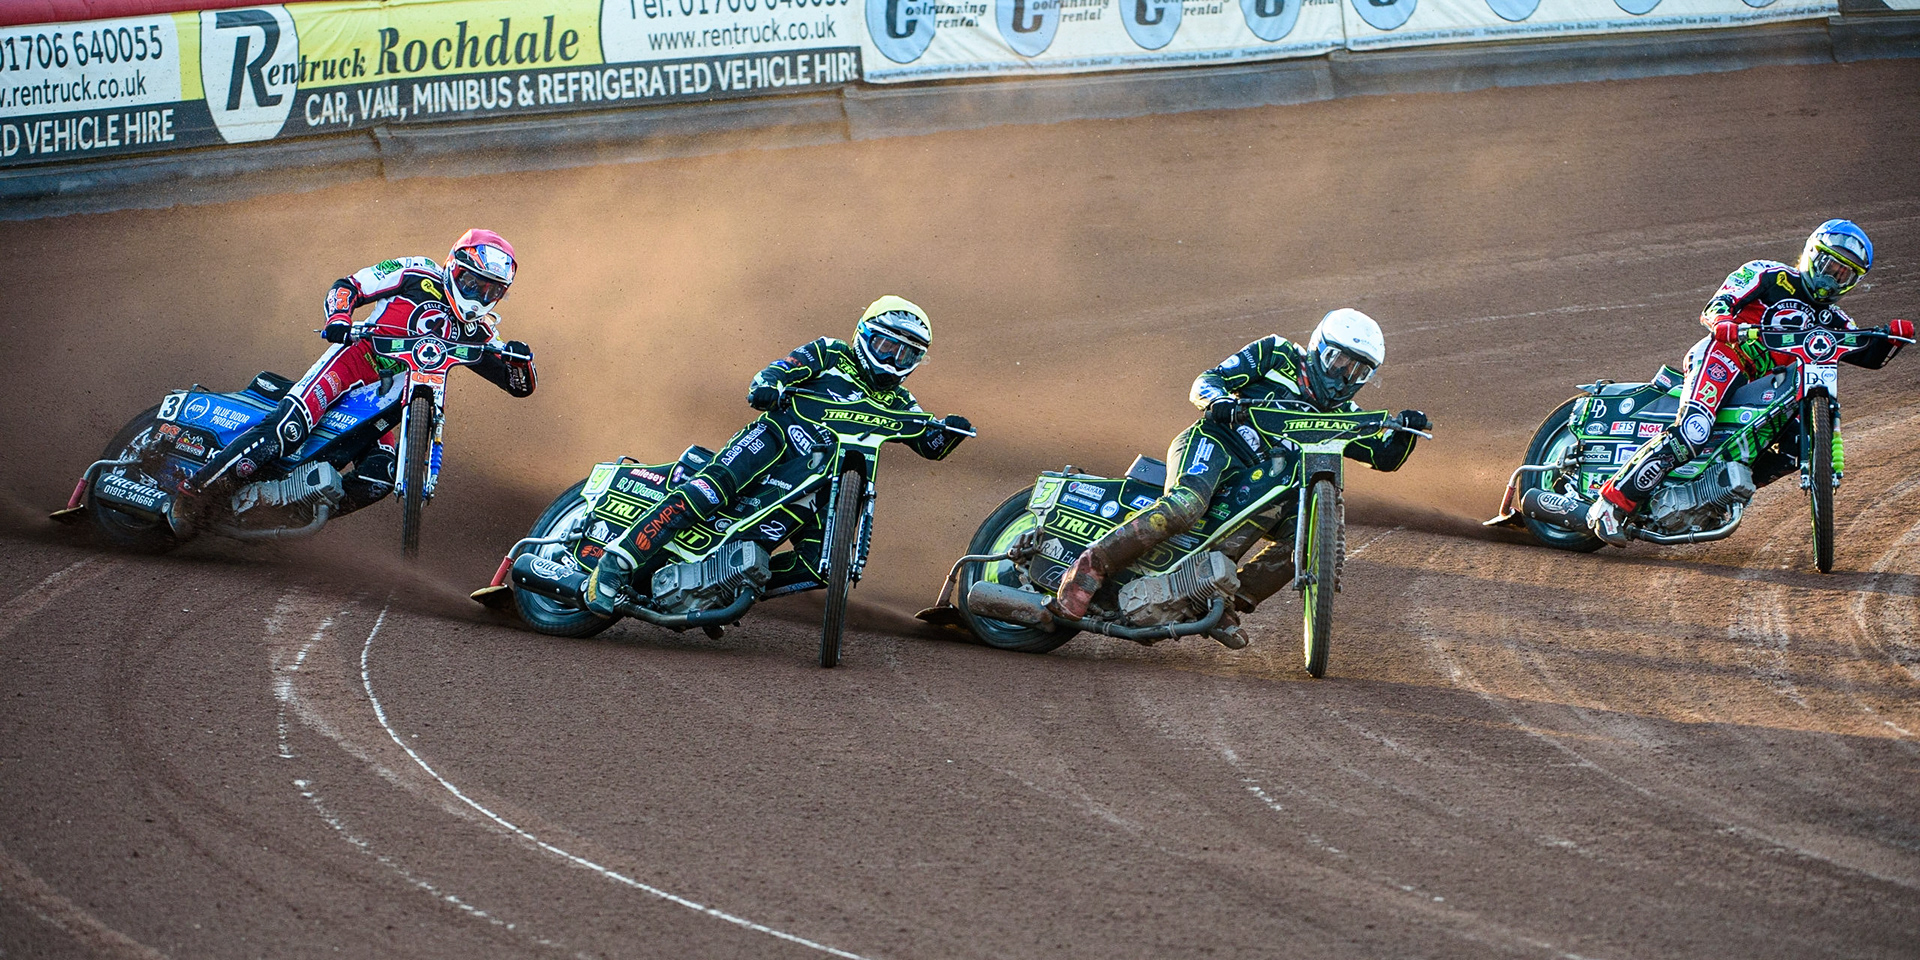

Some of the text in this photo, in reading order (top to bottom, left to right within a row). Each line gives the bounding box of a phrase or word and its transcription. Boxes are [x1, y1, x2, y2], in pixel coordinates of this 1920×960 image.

[936, 16, 980, 28] rental
[1061, 8, 1102, 22] rental
[648, 14, 837, 50] www.rentruck.co.uk
[0, 25, 163, 73] 1706 640055
[374, 15, 580, 76] Rochdale
[305, 51, 859, 127] CAR, VAN, MINIBUS & REFRIGERATED VEHICLE HIRE
[25, 115, 120, 154] VEHICLE
[125, 108, 175, 145] HIRE
[163, 396, 180, 418] 3
[212, 405, 251, 424] BLUE DOOR
[828, 411, 854, 421] TRU
[210, 415, 241, 431] PROJECT
[1288, 421, 1358, 430] TRU PLANT
[1639, 424, 1662, 434] NGK
[1689, 420, 1706, 437] ATPI
[103, 474, 168, 499] PREMIER
[630, 468, 666, 485] milesey
[103, 485, 155, 508] 01912 341666
[1033, 482, 1058, 504] 3
[605, 499, 642, 520] TRU
[643, 500, 686, 539] SIMPLY
[1057, 515, 1097, 537] TRU
